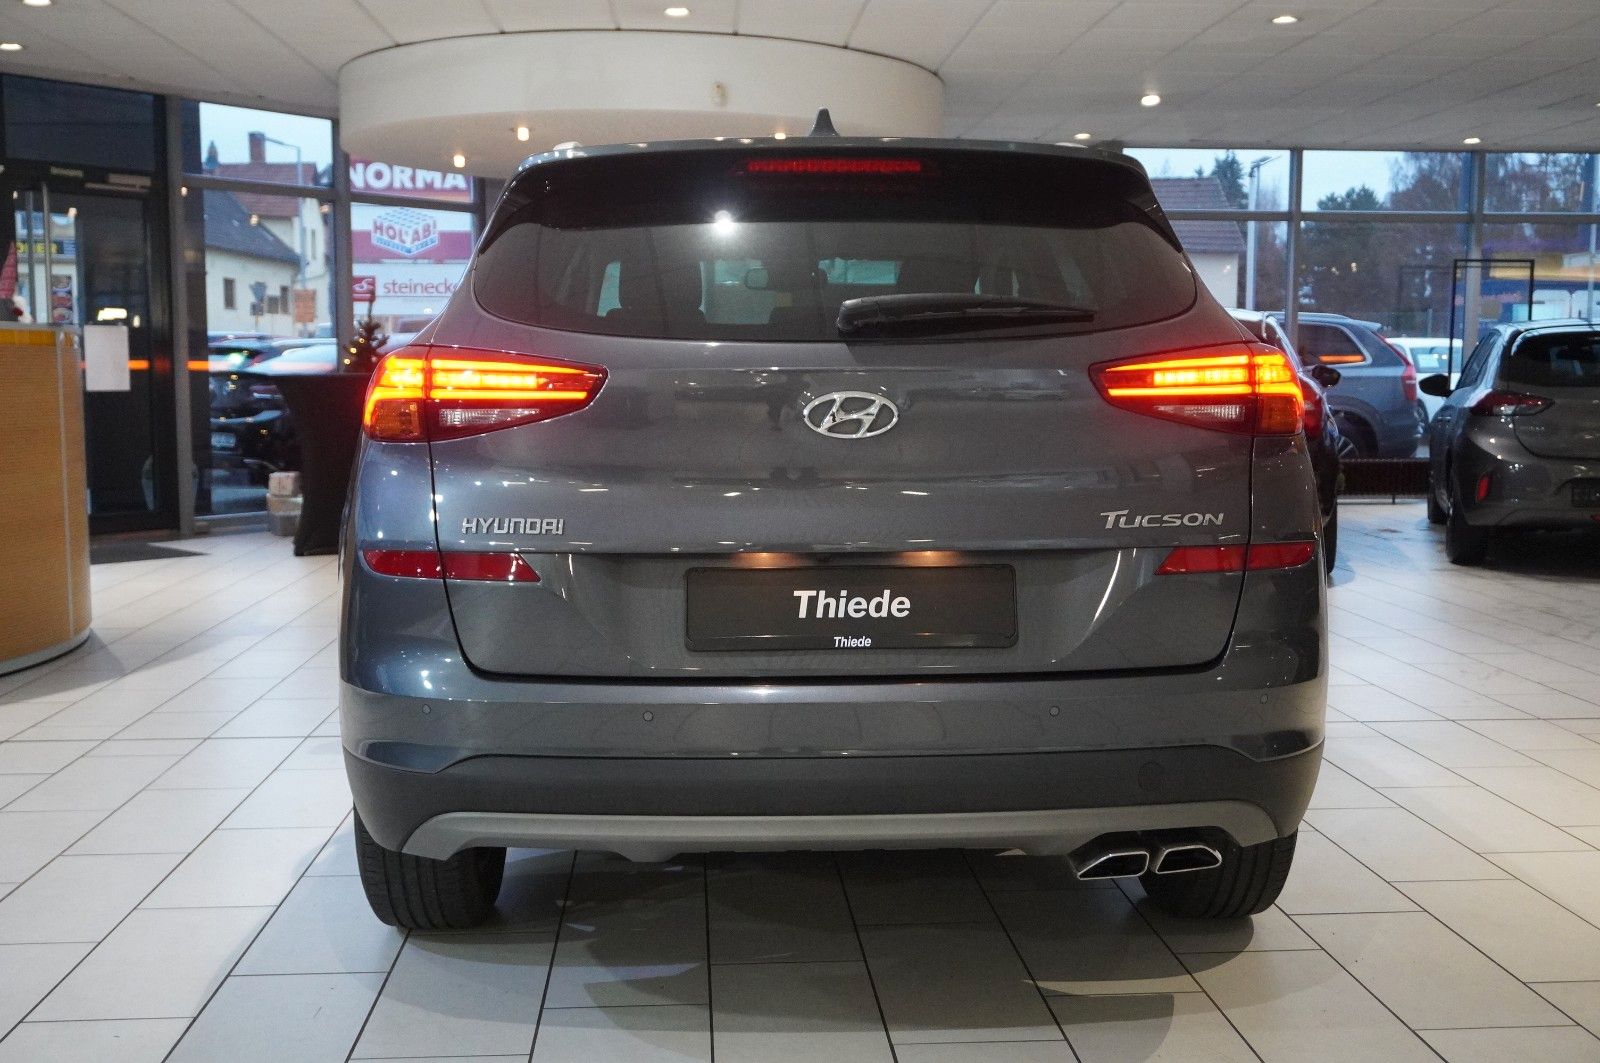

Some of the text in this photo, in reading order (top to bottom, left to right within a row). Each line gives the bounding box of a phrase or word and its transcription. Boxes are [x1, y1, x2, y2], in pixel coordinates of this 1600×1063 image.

[350, 162, 468, 190] NORMA
[461, 517, 564, 535] HYUNDAI
[1100, 509, 1225, 529] TUCSON
[793, 589, 911, 619] Thiede
[833, 636, 872, 648] Thiede
